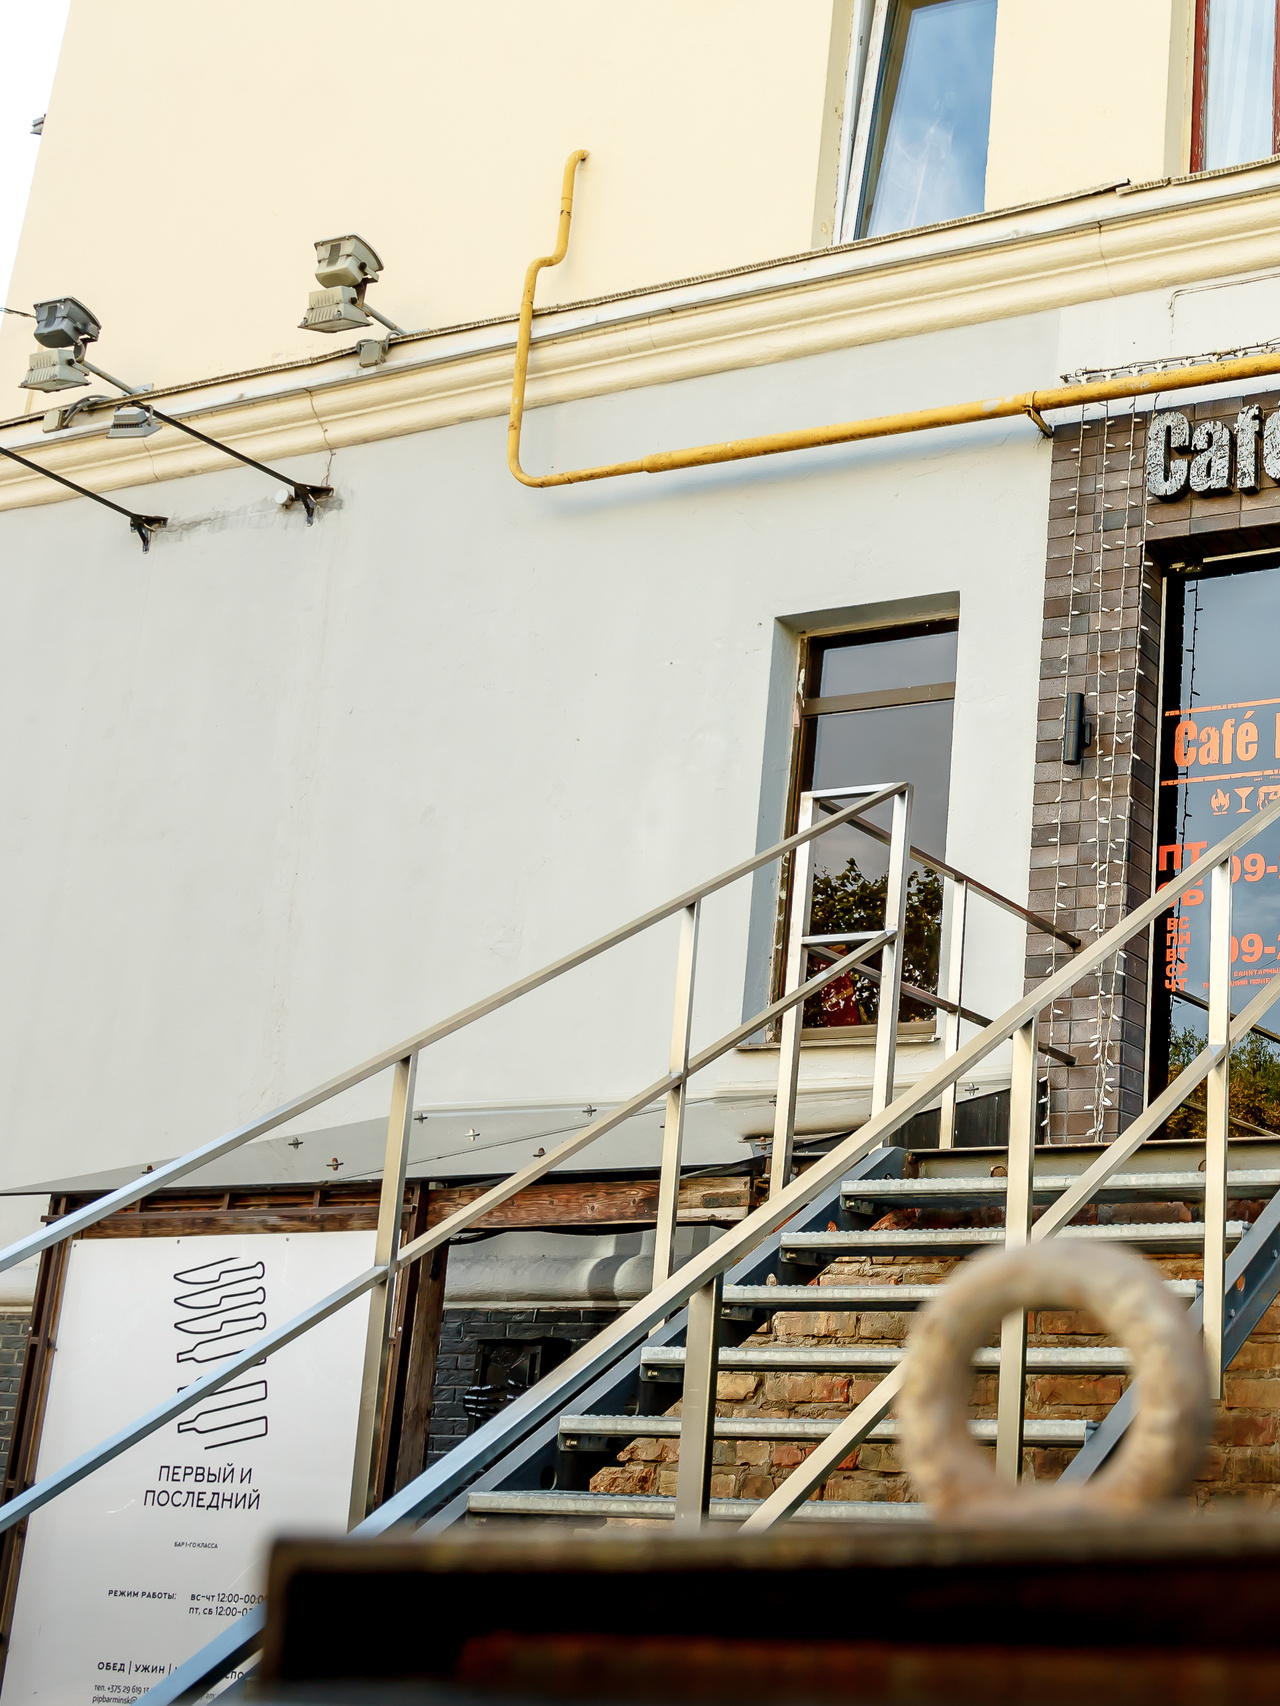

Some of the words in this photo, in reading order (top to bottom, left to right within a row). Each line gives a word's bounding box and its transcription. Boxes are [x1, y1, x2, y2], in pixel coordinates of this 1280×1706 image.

[1173, 711, 1258, 767] Café
[1158, 841, 1207, 872] ПТ
[1166, 916, 1190, 931] ВС
[1166, 932, 1191, 946] ПН
[1165, 947, 1189, 962] ВТ
[1165, 963, 1189, 977] СР
[158, 1462, 235, 1484] ПЕРВЫЙ
[240, 1467, 252, 1484] И
[143, 1489, 260, 1511] ПОСЛЕДНИЙ
[108, 1589, 139, 1598] РЕЖИМ
[141, 1591, 177, 1600] РАБОТЫ:
[97, 1661, 125, 1673] ОБЕД
[134, 1664, 165, 1675] УЖИН
[107, 1685, 121, 1694] +375
[122, 1685, 130, 1694] 29
